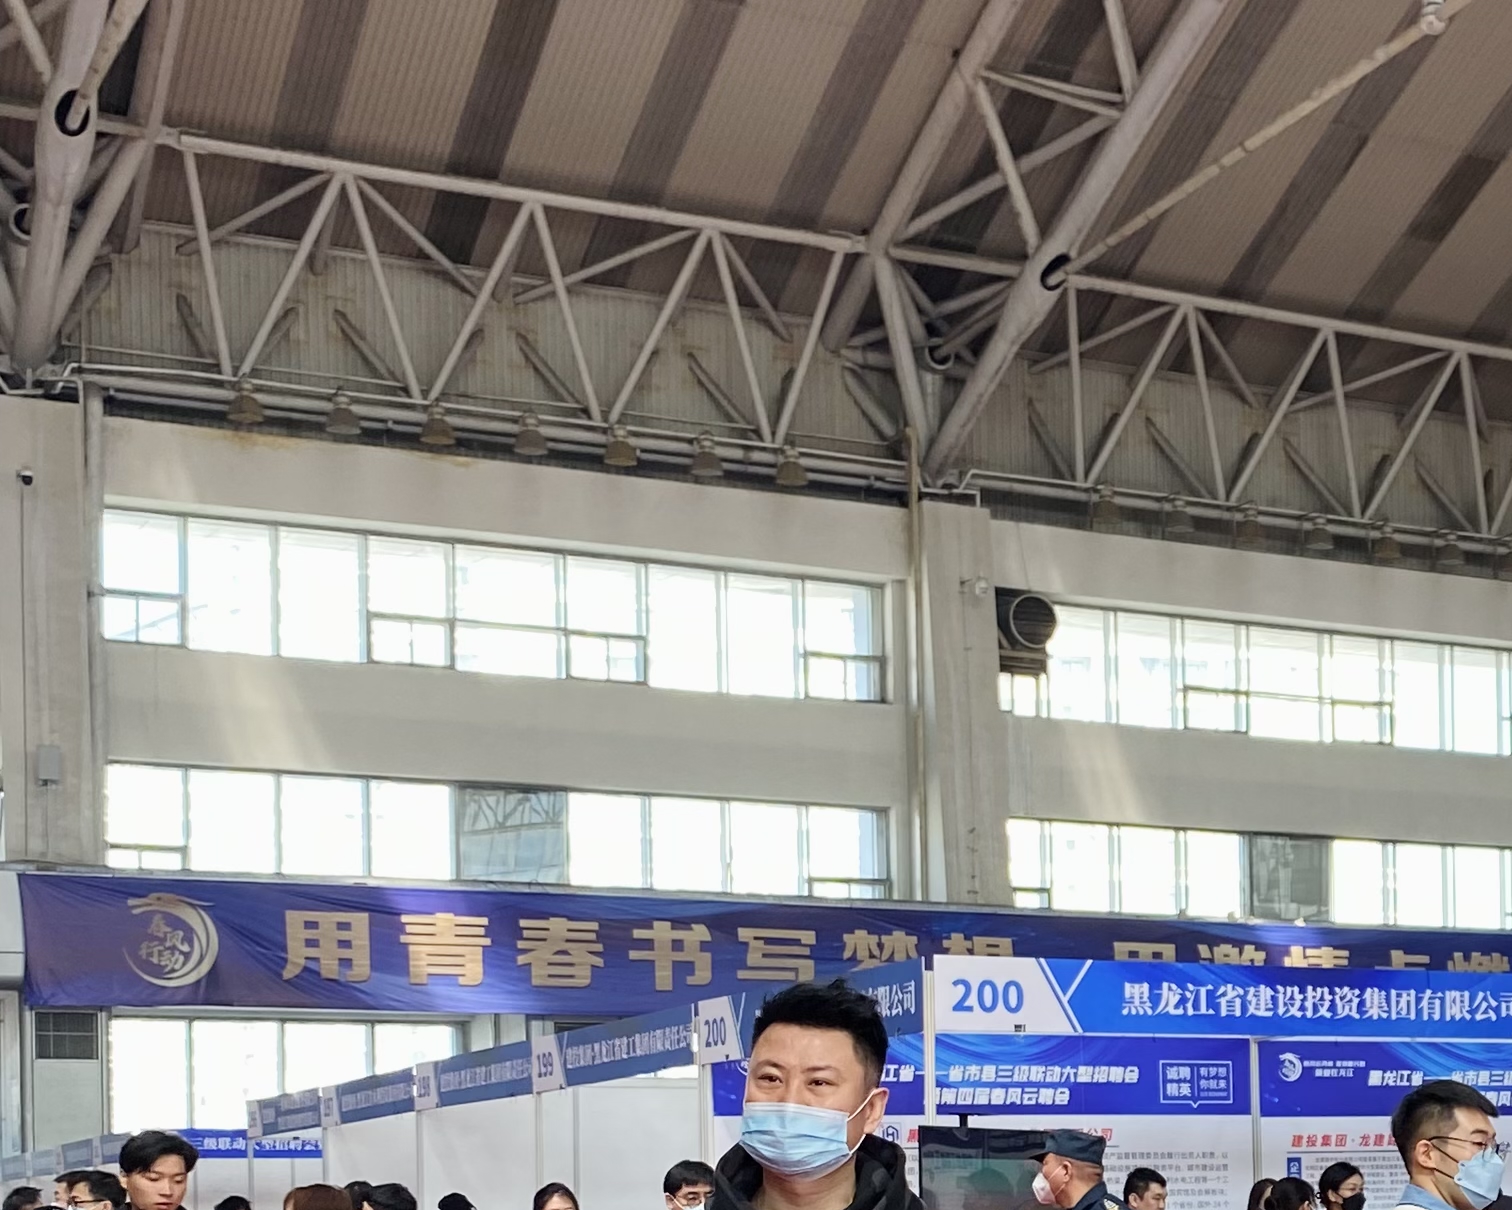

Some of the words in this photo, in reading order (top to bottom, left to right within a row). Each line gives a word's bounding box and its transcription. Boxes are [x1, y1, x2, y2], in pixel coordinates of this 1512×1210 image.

[951, 978, 1024, 1014] 200
[704, 1016, 727, 1047] 200
[536, 1051, 554, 1078] 199
